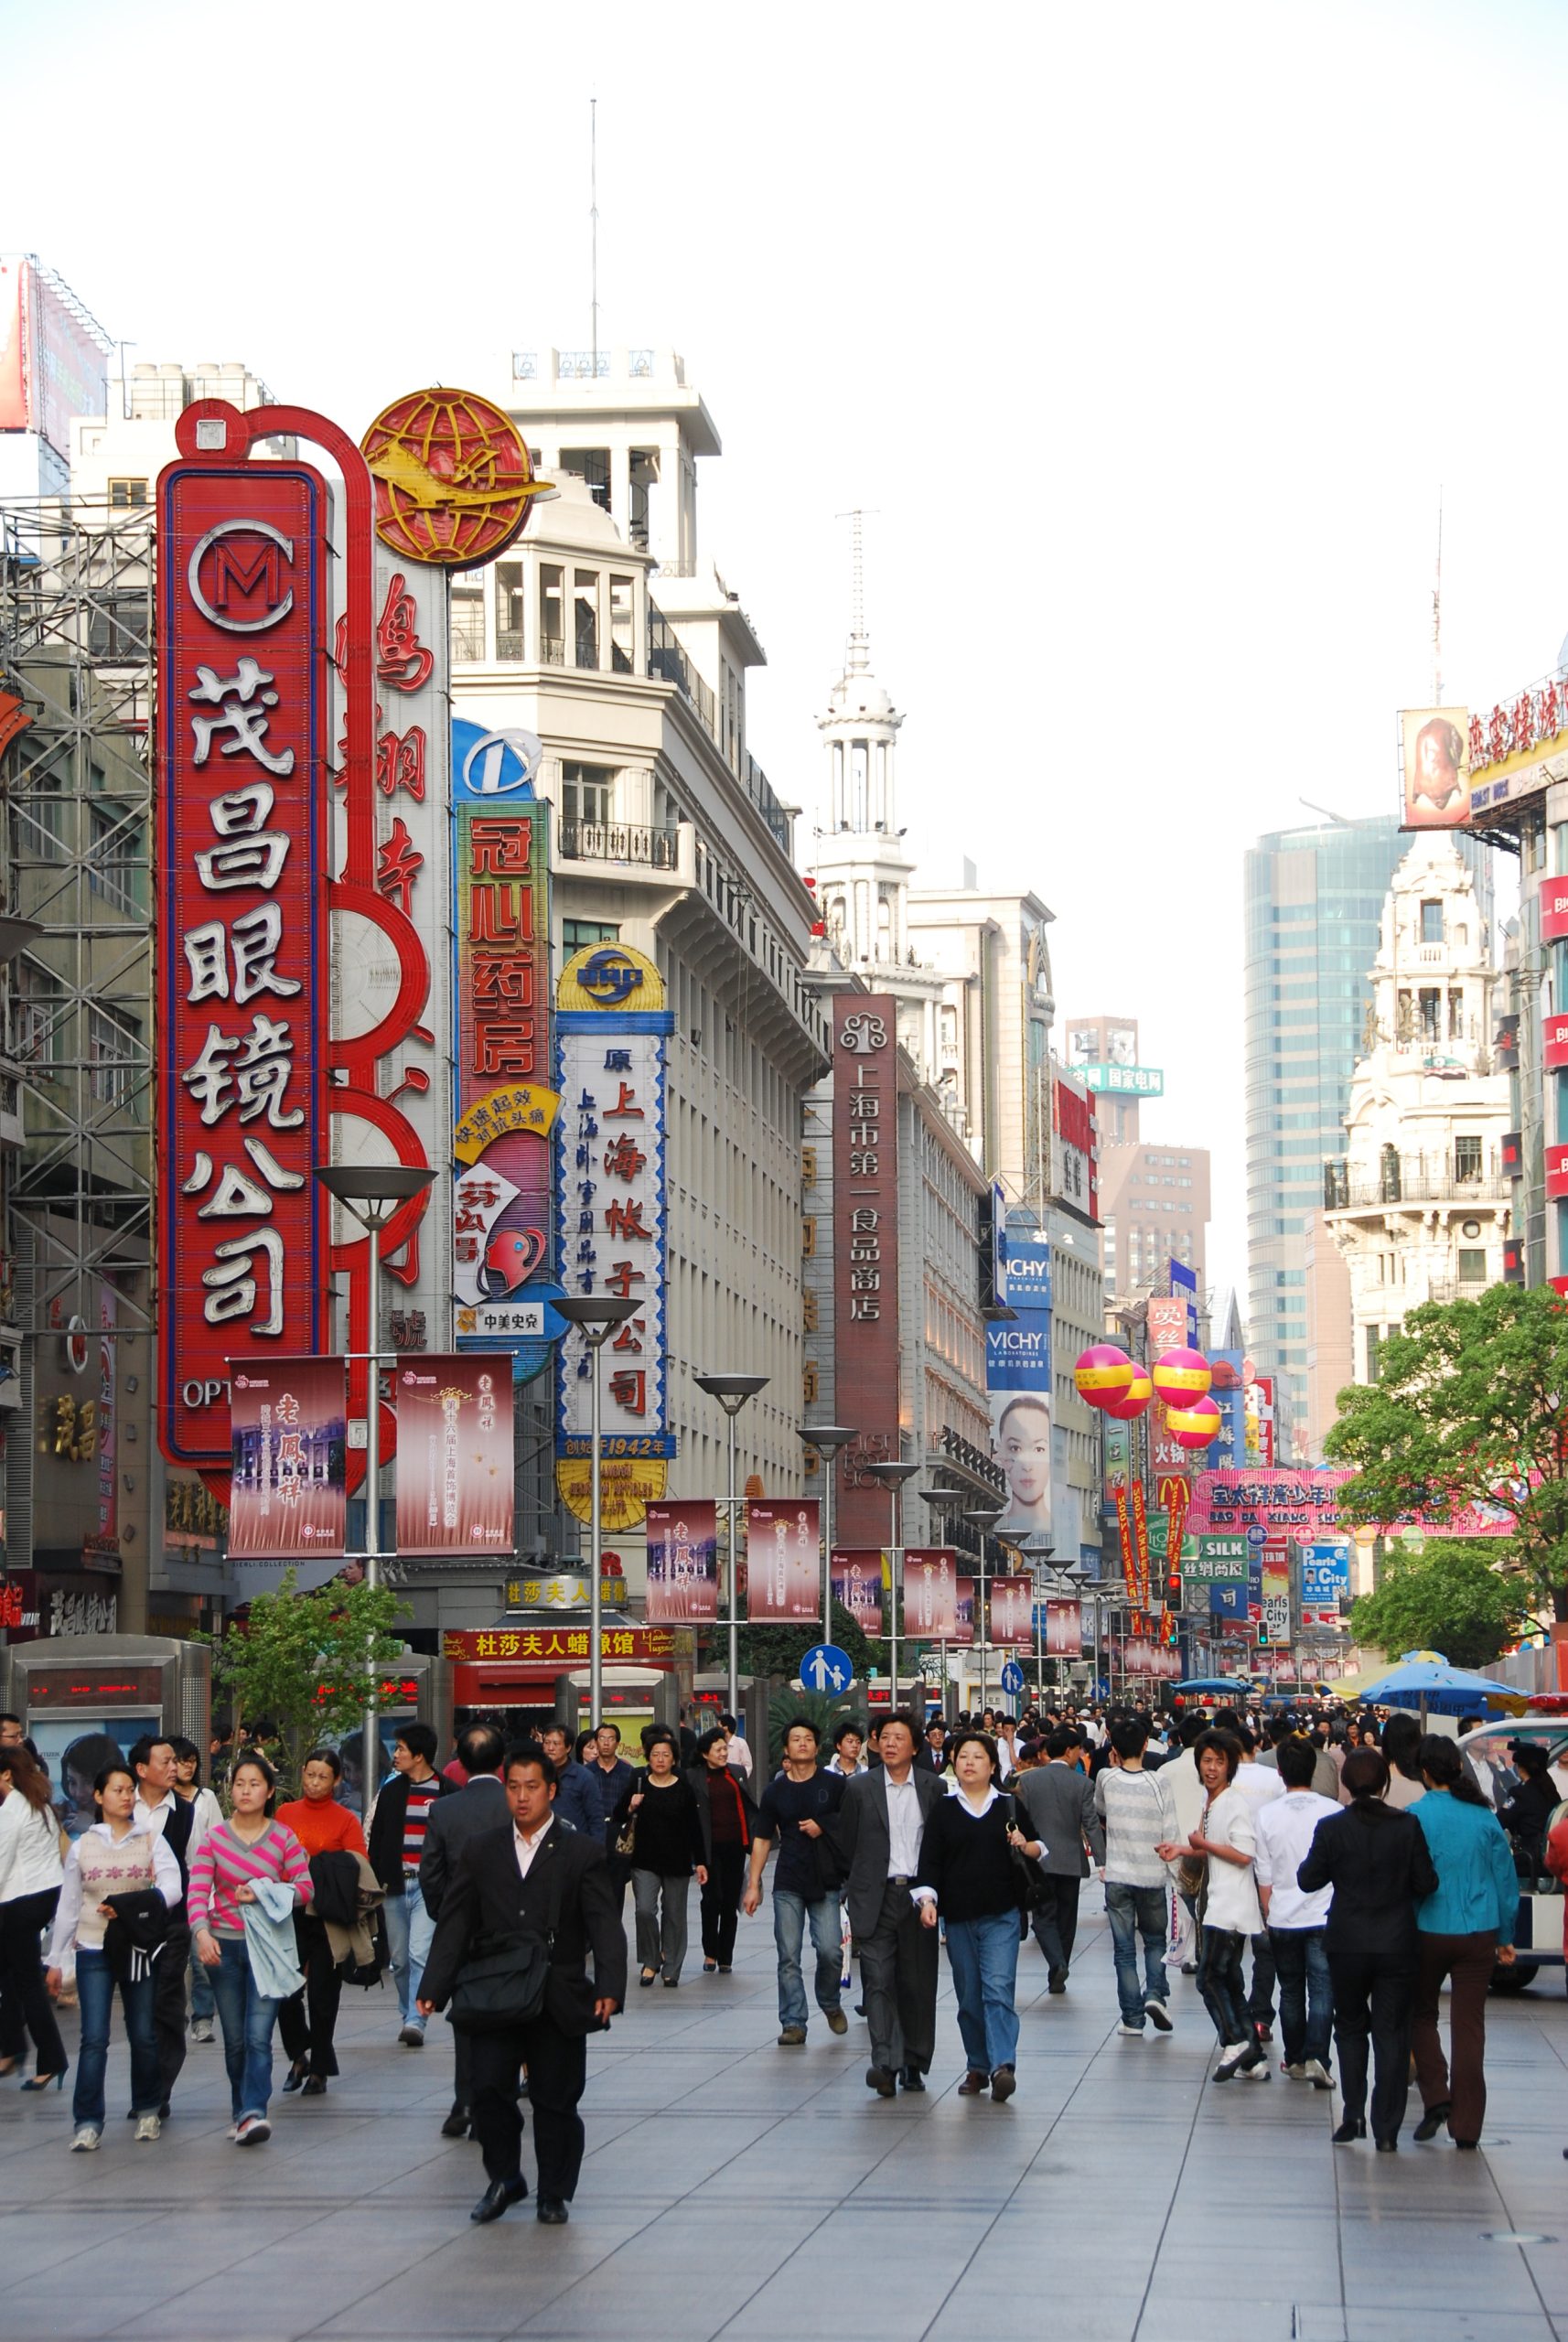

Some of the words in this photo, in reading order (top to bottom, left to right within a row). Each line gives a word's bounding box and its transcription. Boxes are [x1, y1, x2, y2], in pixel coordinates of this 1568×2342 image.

[468, 816, 535, 1075] 冠心药房
[183, 657, 305, 1337] 茂昌眼镜公司
[1109, 1069, 1161, 1092] 国家电网
[456, 1088, 532, 1145] 快速起效
[849, 1064, 881, 1322] 上海市第一食品商店
[602, 1080, 653, 1415] 上海帐子公司
[1006, 1259, 1046, 1277] ICHY
[484, 1313, 539, 1330] 中美史克
[987, 1331, 1043, 1350] VICHY
[1155, 1442, 1187, 1465] 火锅
[1208, 1512, 1234, 1523] BAO
[1241, 1512, 1258, 1523] DA
[1267, 1512, 1308, 1524] XIANG
[1207, 1542, 1243, 1555] SILK
[1303, 1548, 1337, 1566] Pearls
[1318, 1567, 1348, 1585] City
[1262, 1596, 1288, 1608] earls
[1266, 1609, 1288, 1626] City
[476, 1632, 635, 1657] 杜莎夫人蜡像馆
